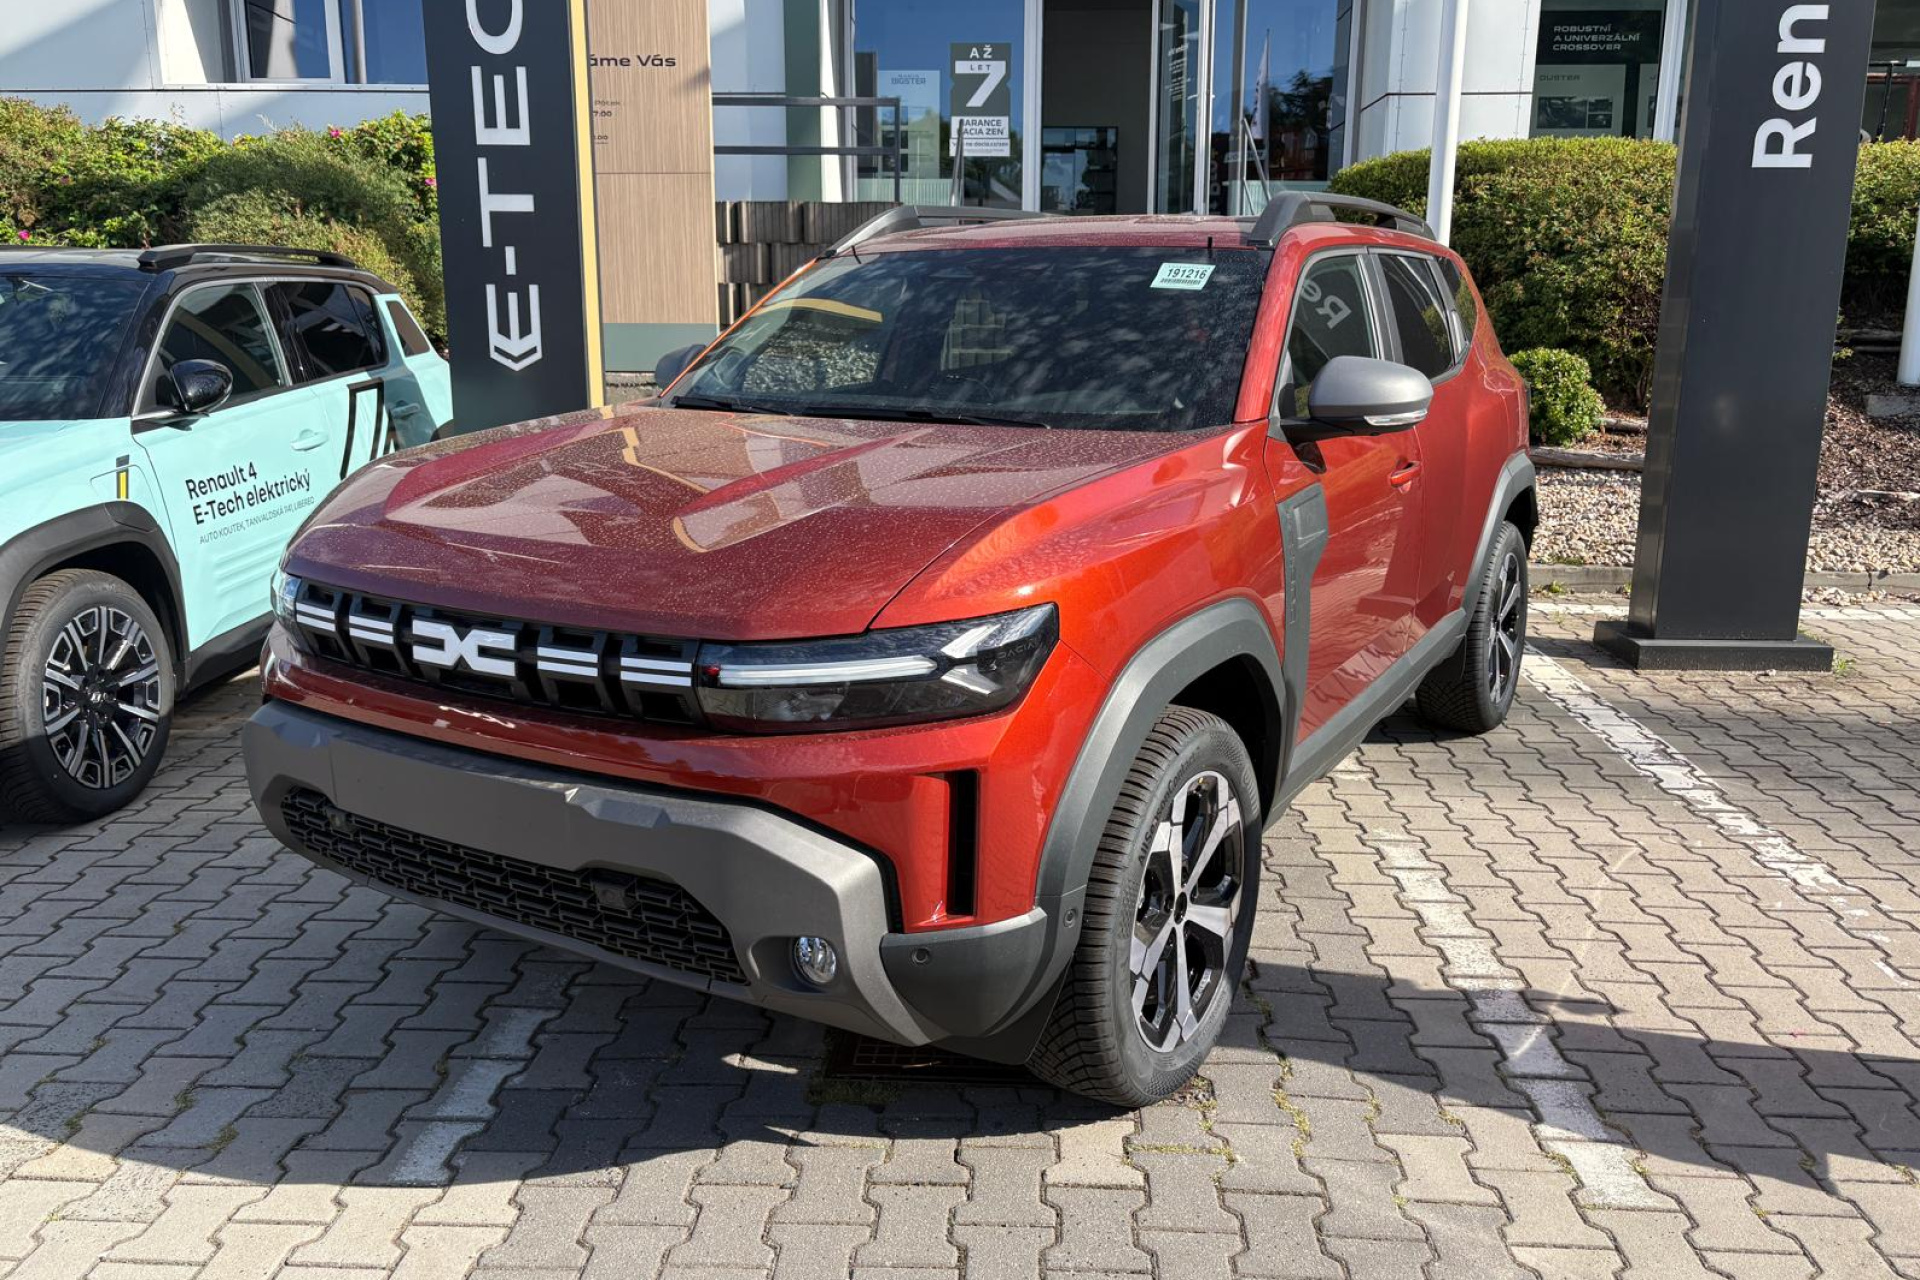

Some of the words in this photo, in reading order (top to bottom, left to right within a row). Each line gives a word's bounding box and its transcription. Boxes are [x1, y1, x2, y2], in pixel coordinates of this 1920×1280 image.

[1553, 24, 1612, 32] ROBUSTNÍ
[1553, 34, 1562, 42] A
[1564, 33, 1640, 42] UNIVERZÁLNÍ
[969, 44, 993, 59] AŽ
[1552, 43, 1622, 51] CROSSOVER
[636, 54, 677, 67] Vás
[954, 60, 1007, 107] 7
[1751, 4, 1830, 169] Ren
[959, 119, 1002, 127] ARANCE
[958, 127, 984, 136] ACIA
[1167, 268, 1208, 280] 191216
[185, 465, 247, 500] Renault
[248, 461, 258, 480] 4
[192, 491, 246, 526] E-Tech
[246, 468, 311, 508] elektrický
